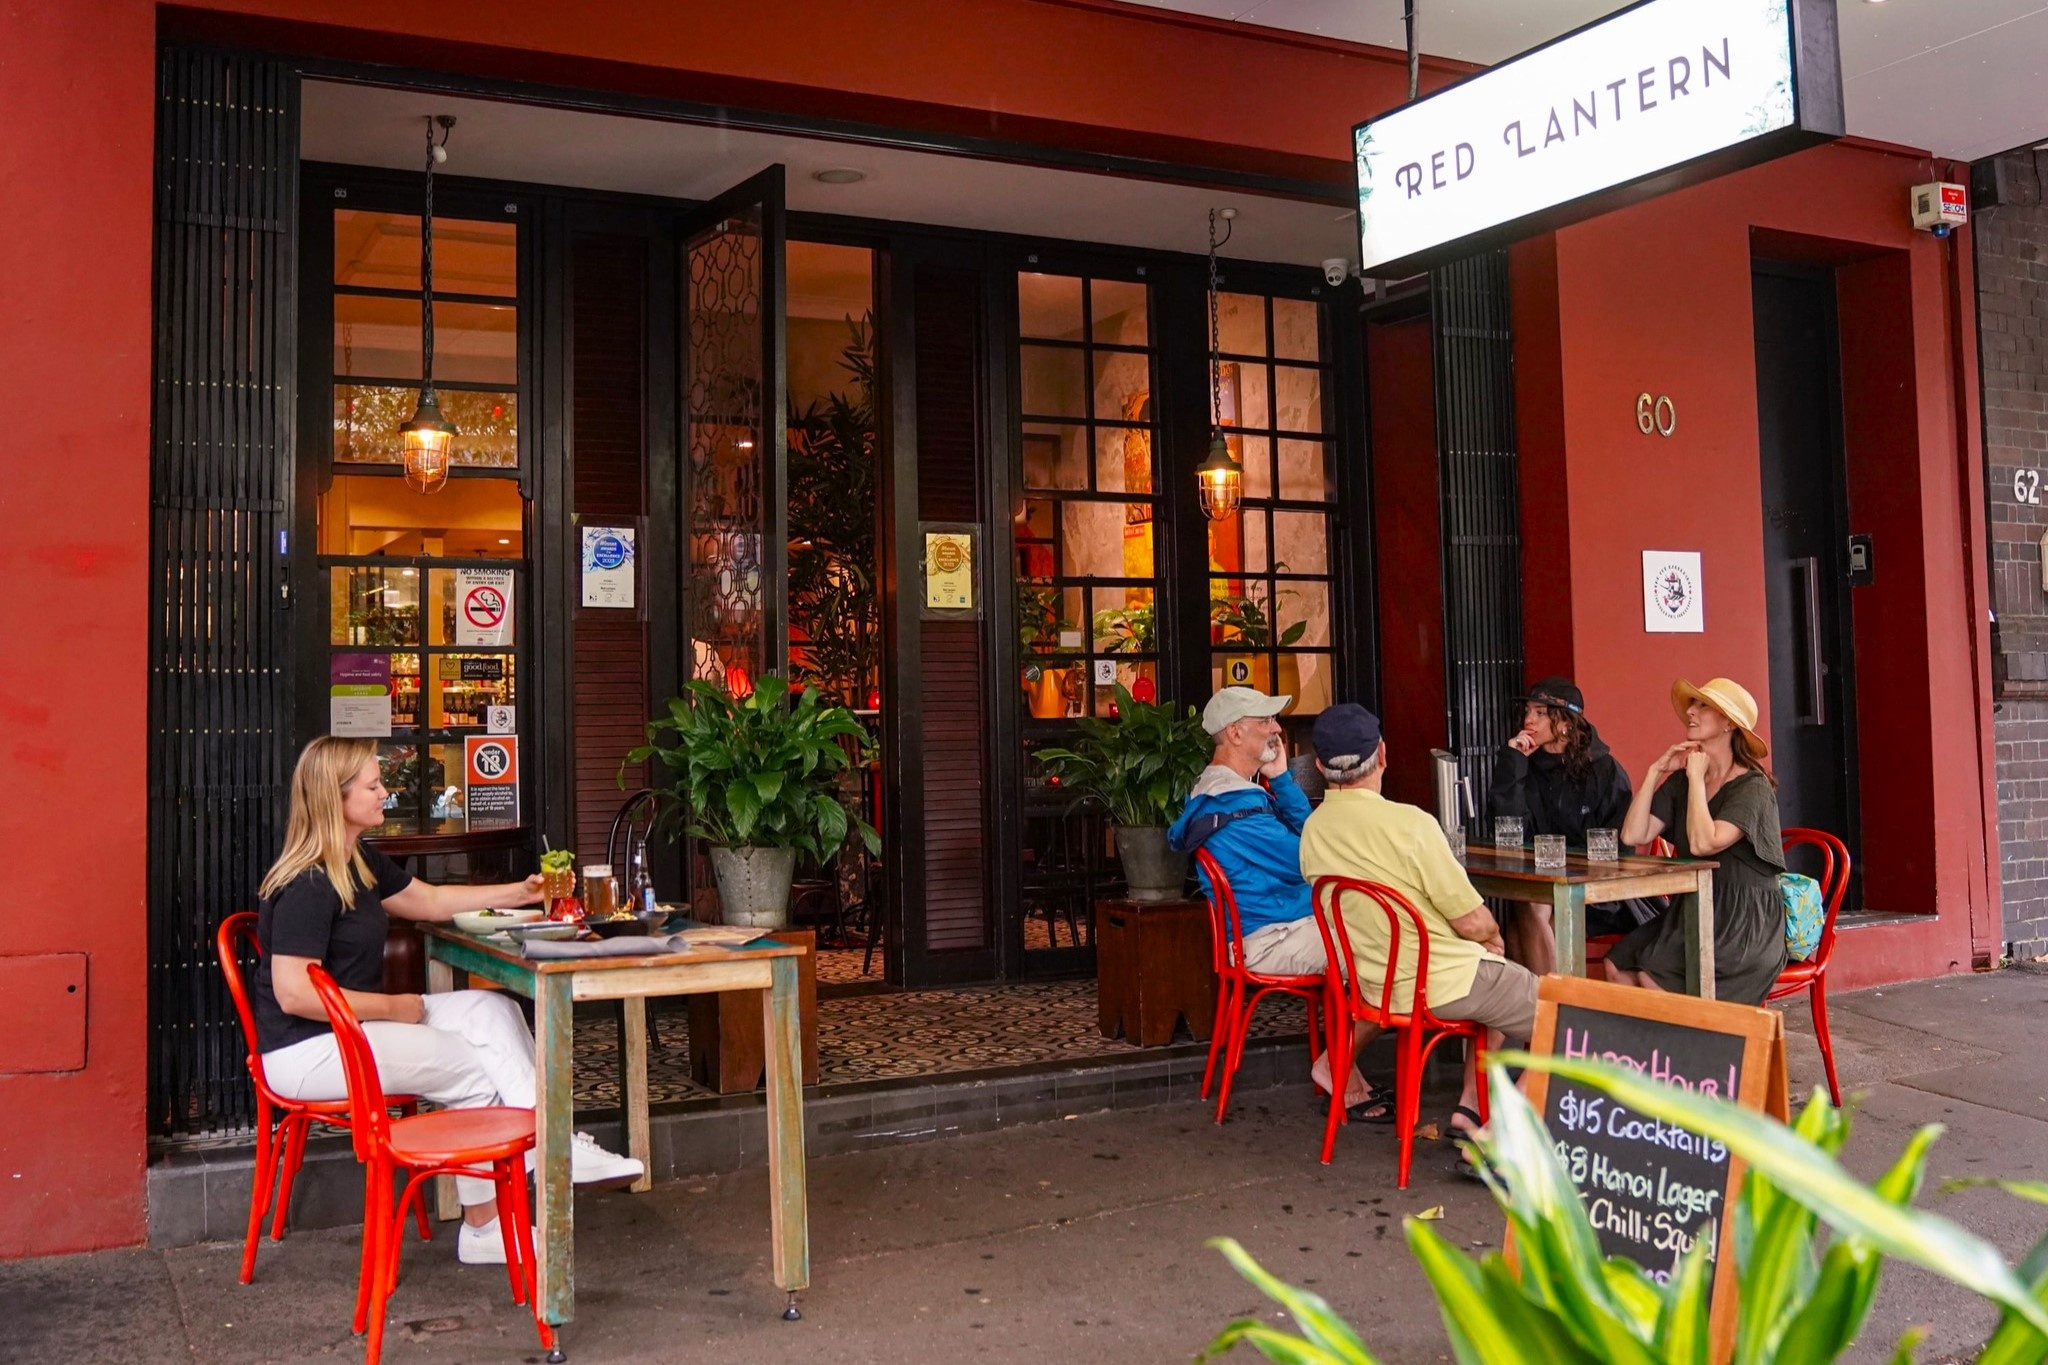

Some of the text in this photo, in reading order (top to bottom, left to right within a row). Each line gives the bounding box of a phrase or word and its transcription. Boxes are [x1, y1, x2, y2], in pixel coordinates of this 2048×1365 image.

[1395, 38, 1730, 200] RED LANTERN
[1637, 393, 1676, 437] 60
[482, 756, 500, 772] 18
[1559, 1089, 1727, 1163] $15 Cocktails
[1591, 1152, 1653, 1200] Hanoi
[1657, 1166, 1719, 1224] Lager
[1589, 1198, 1649, 1243] Chilli
